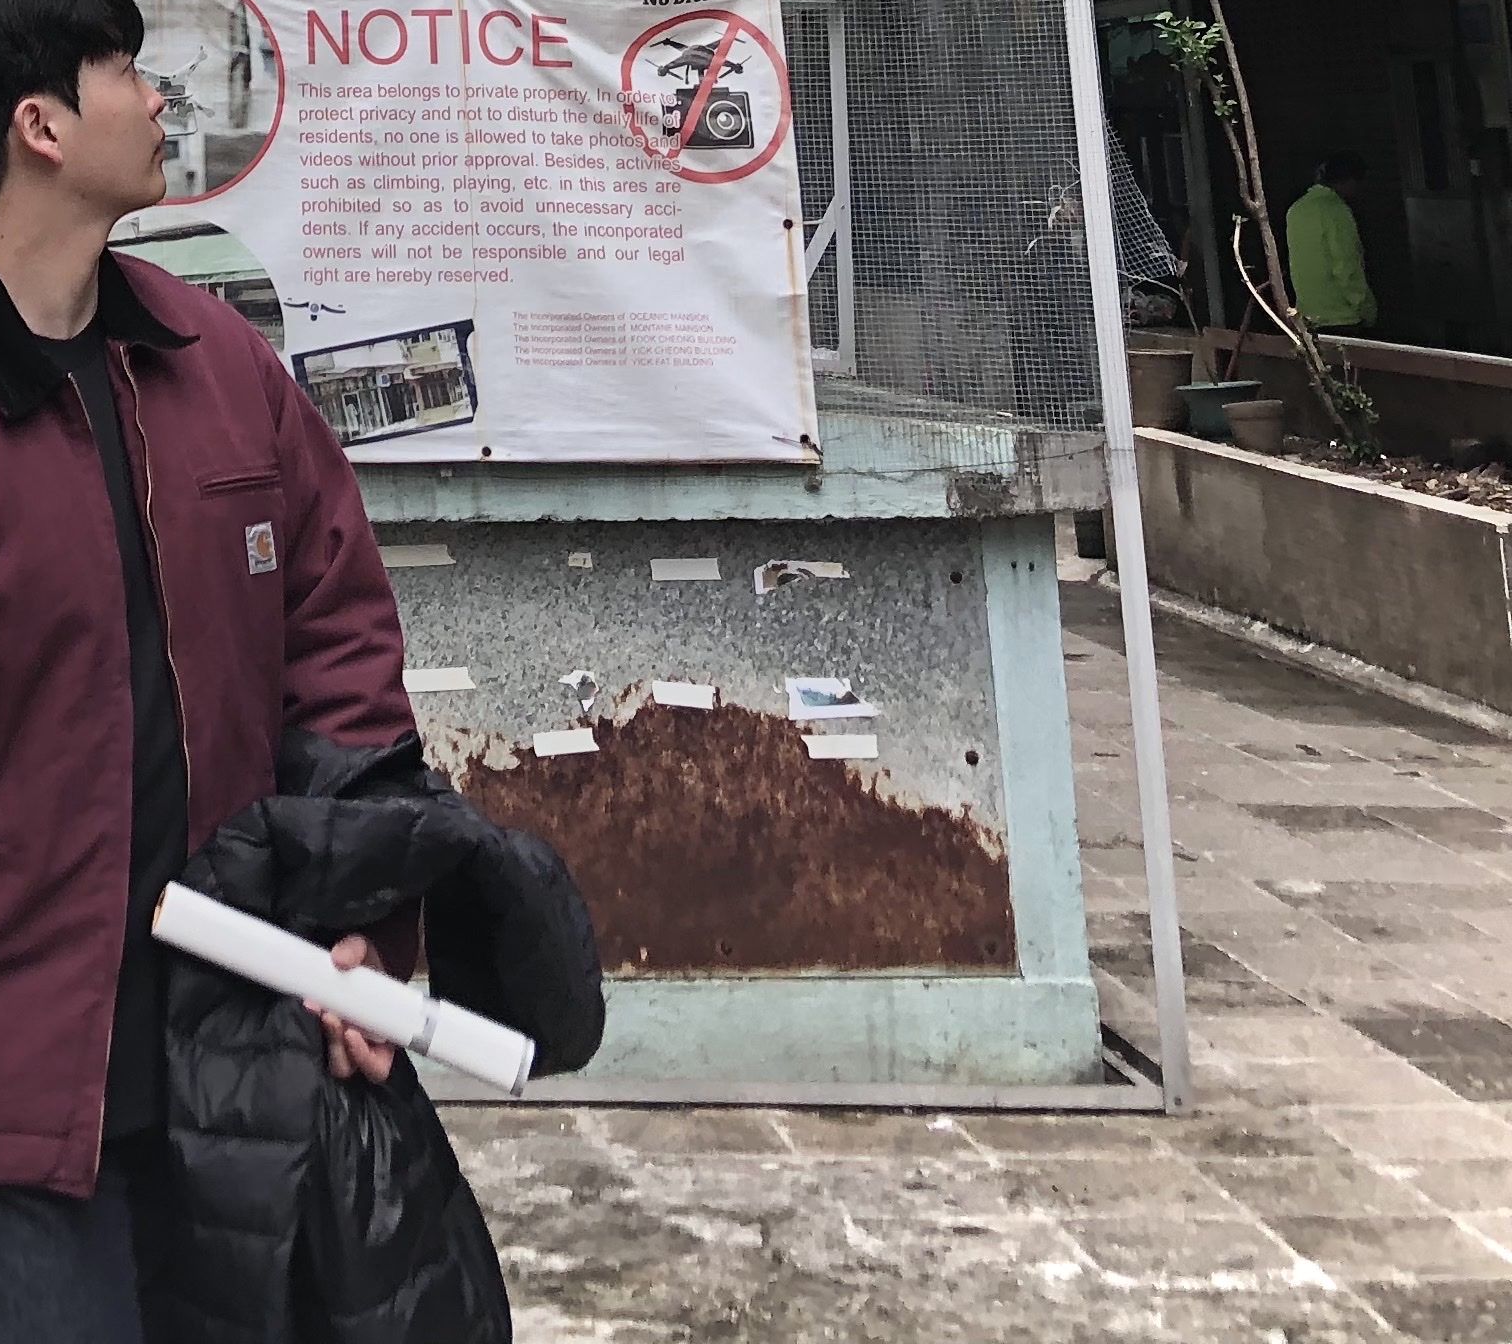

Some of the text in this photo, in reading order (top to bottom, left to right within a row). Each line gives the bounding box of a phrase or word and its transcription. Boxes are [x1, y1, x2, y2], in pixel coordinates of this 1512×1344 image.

[306, 9, 573, 67] NOTICE
[298, 83, 331, 98] This
[337, 86, 372, 98] area
[378, 84, 440, 101] belongs
[446, 85, 460, 98] to
[466, 85, 518, 100] private
[523, 87, 590, 104] property.
[597, 88, 610, 101] In
[617, 90, 656, 103] order
[299, 107, 679, 127] protect privacy and not to disturb the daily life of
[299, 130, 679, 149] residents, no one is allowed to take photos and
[300, 152, 352, 166] videos
[358, 152, 416, 166] without
[422, 152, 458, 169] prior
[465, 152, 538, 170] approval.
[545, 153, 609, 171] Besides,
[301, 175, 681, 193] such as climbing, playing, etc. in this ares are
[302, 199, 682, 218] prohibited so as to avoid unnecessary acci-
[302, 221, 351, 235] dents.
[359, 221, 368, 235] If
[376, 224, 404, 239] any
[411, 222, 479, 236] accident
[486, 224, 545, 238] occurs,
[553, 223, 577, 236] the
[303, 245, 684, 265] owners will not be responsible and our legal
[304, 268, 513, 285] right are hereby reserved.
[513, 312, 528, 320] The
[513, 323, 528, 331] The
[514, 335, 529, 343] The
